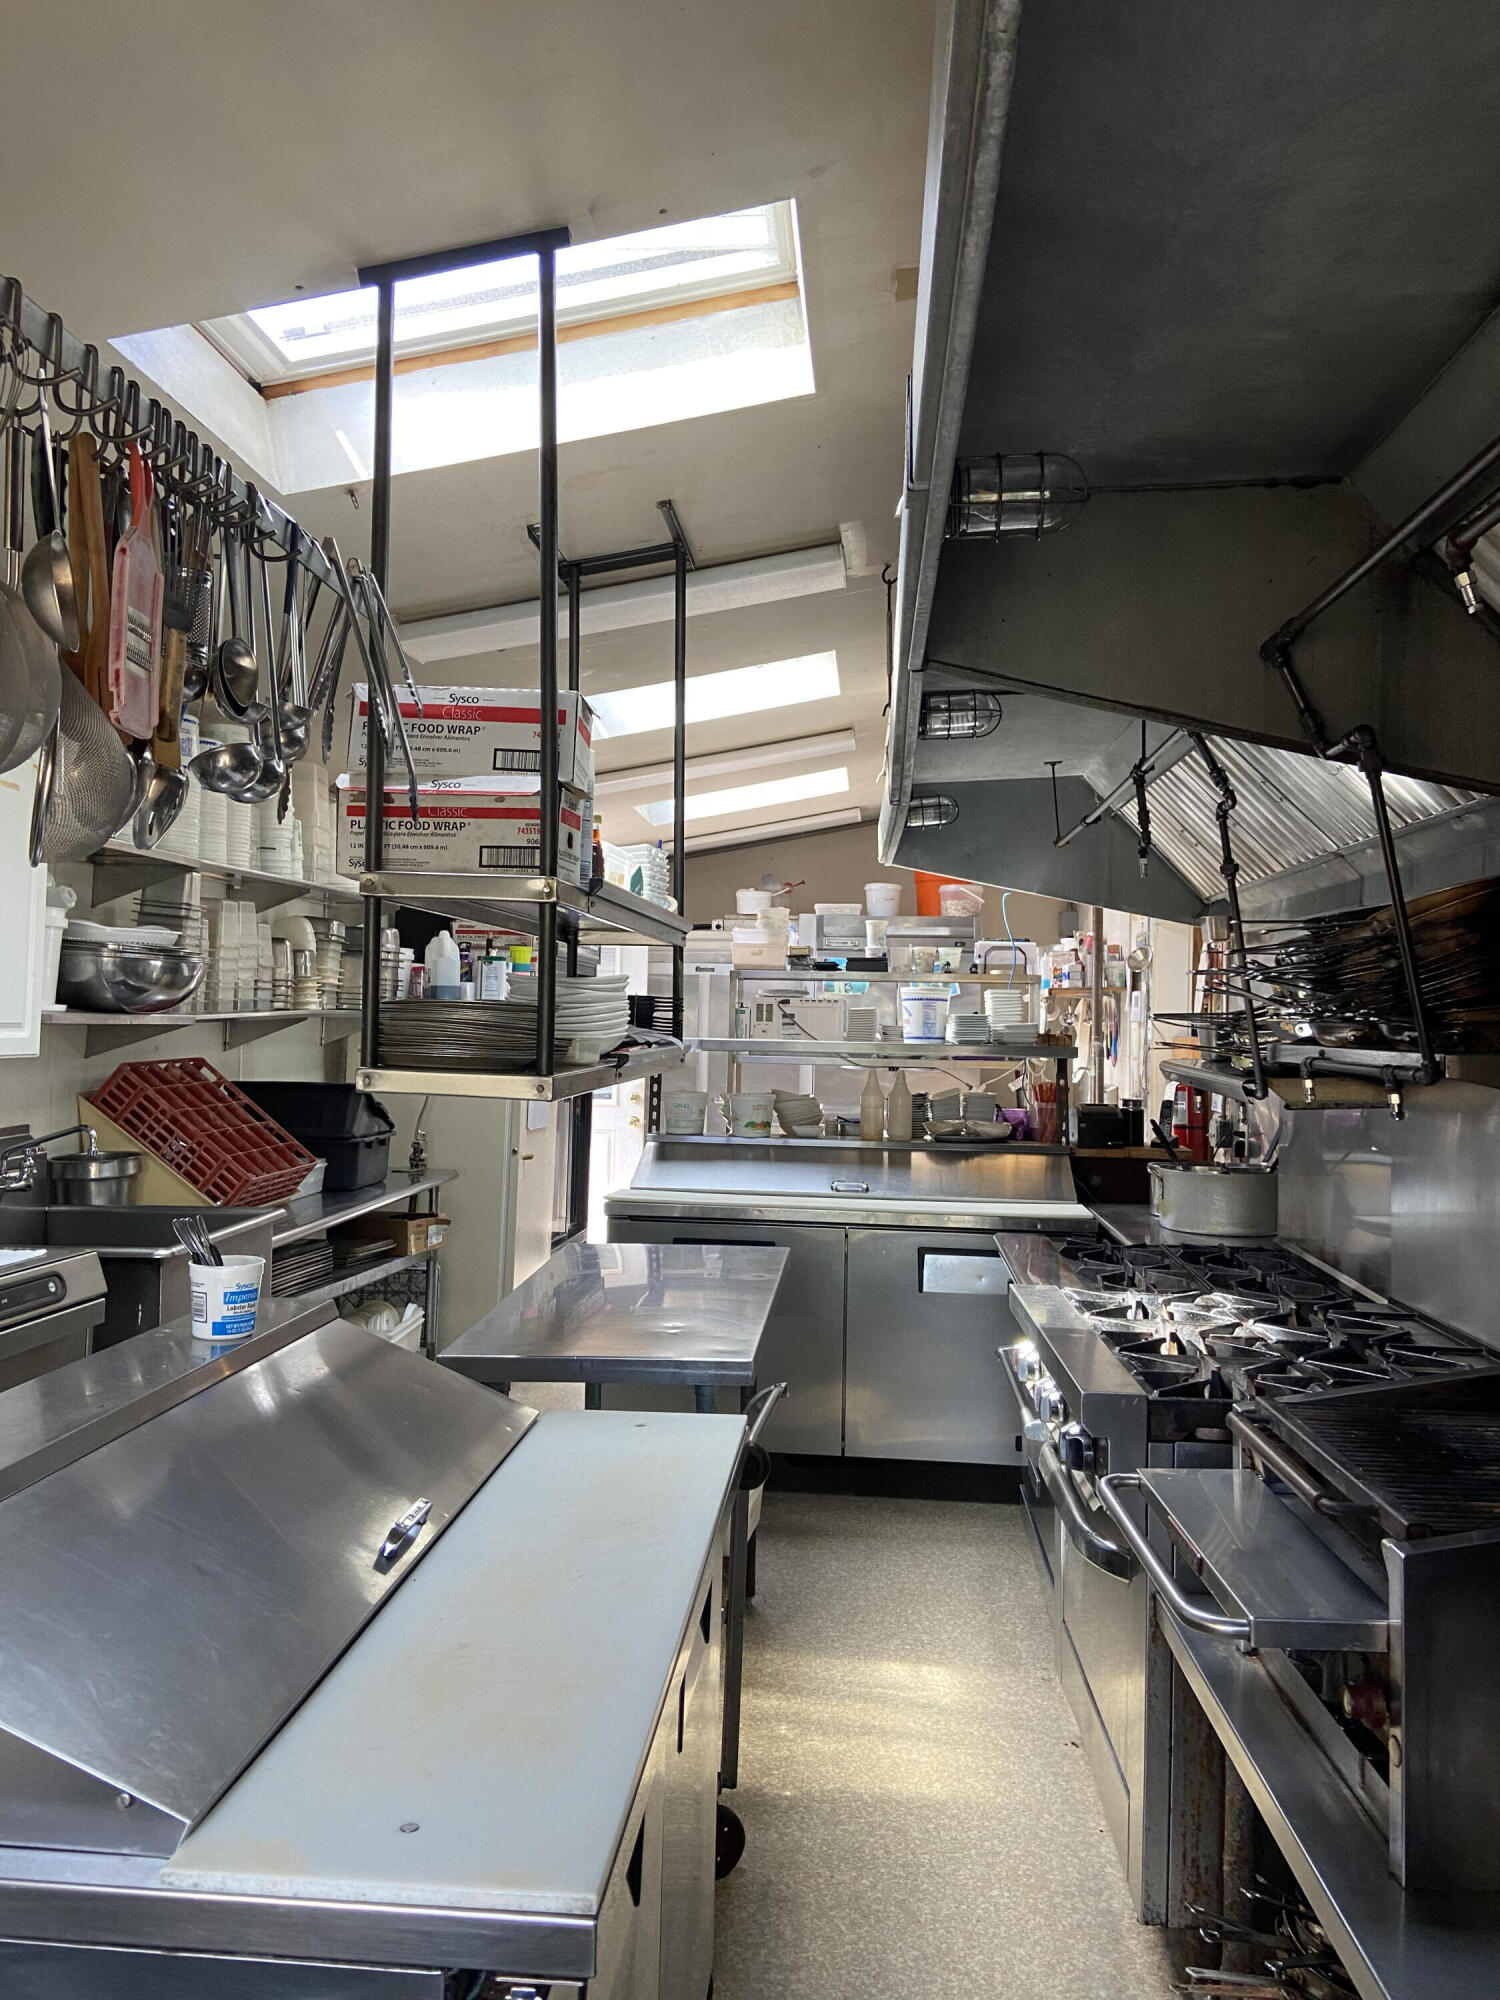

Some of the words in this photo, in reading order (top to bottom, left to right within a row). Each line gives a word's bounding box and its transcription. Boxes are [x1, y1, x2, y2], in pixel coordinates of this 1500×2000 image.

[449, 693, 480, 707] Sysco
[442, 705, 482, 720] Classic
[411, 723, 444, 734] FOOD
[447, 724, 481, 735] WRAP
[430, 779, 461, 790] Sysco
[427, 806, 468, 817] Classic
[350, 820, 396, 831] PLIC
[398, 820, 430, 831] FOOD
[433, 821, 466, 831] WRAP
[517, 827, 541, 835] 743519
[348, 858, 365, 869] Sysc
[236, 1282, 255, 1290] Sysco
